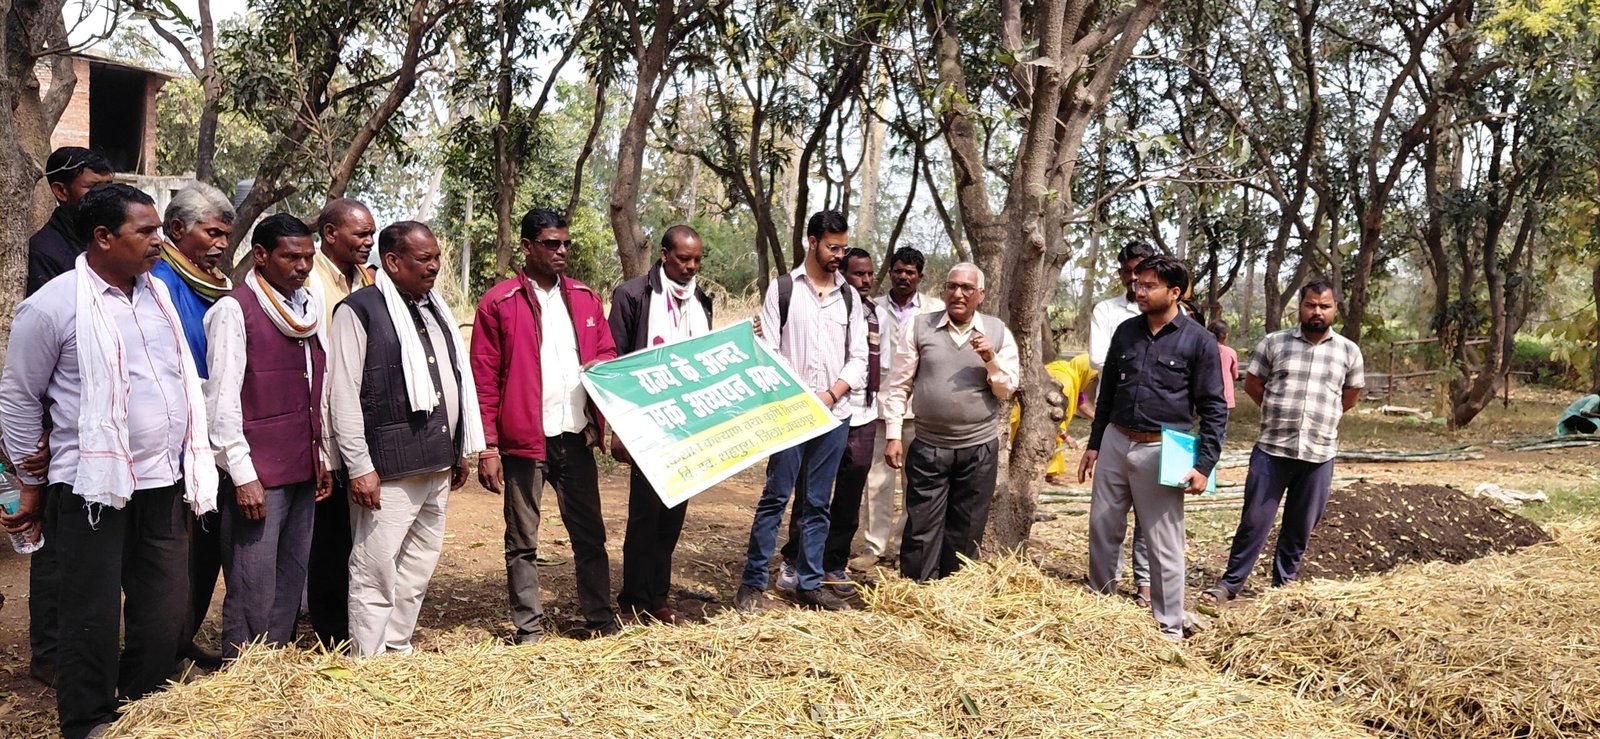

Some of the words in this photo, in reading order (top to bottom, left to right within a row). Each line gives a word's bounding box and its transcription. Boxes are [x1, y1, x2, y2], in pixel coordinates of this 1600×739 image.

[629, 363, 683, 395] राज्य
[669, 352, 701, 384] के
[693, 340, 751, 374] अन्दर
[683, 374, 756, 419] अध्ययन
[704, 425, 742, 447] कल्याण
[742, 415, 764, 431] तथा
